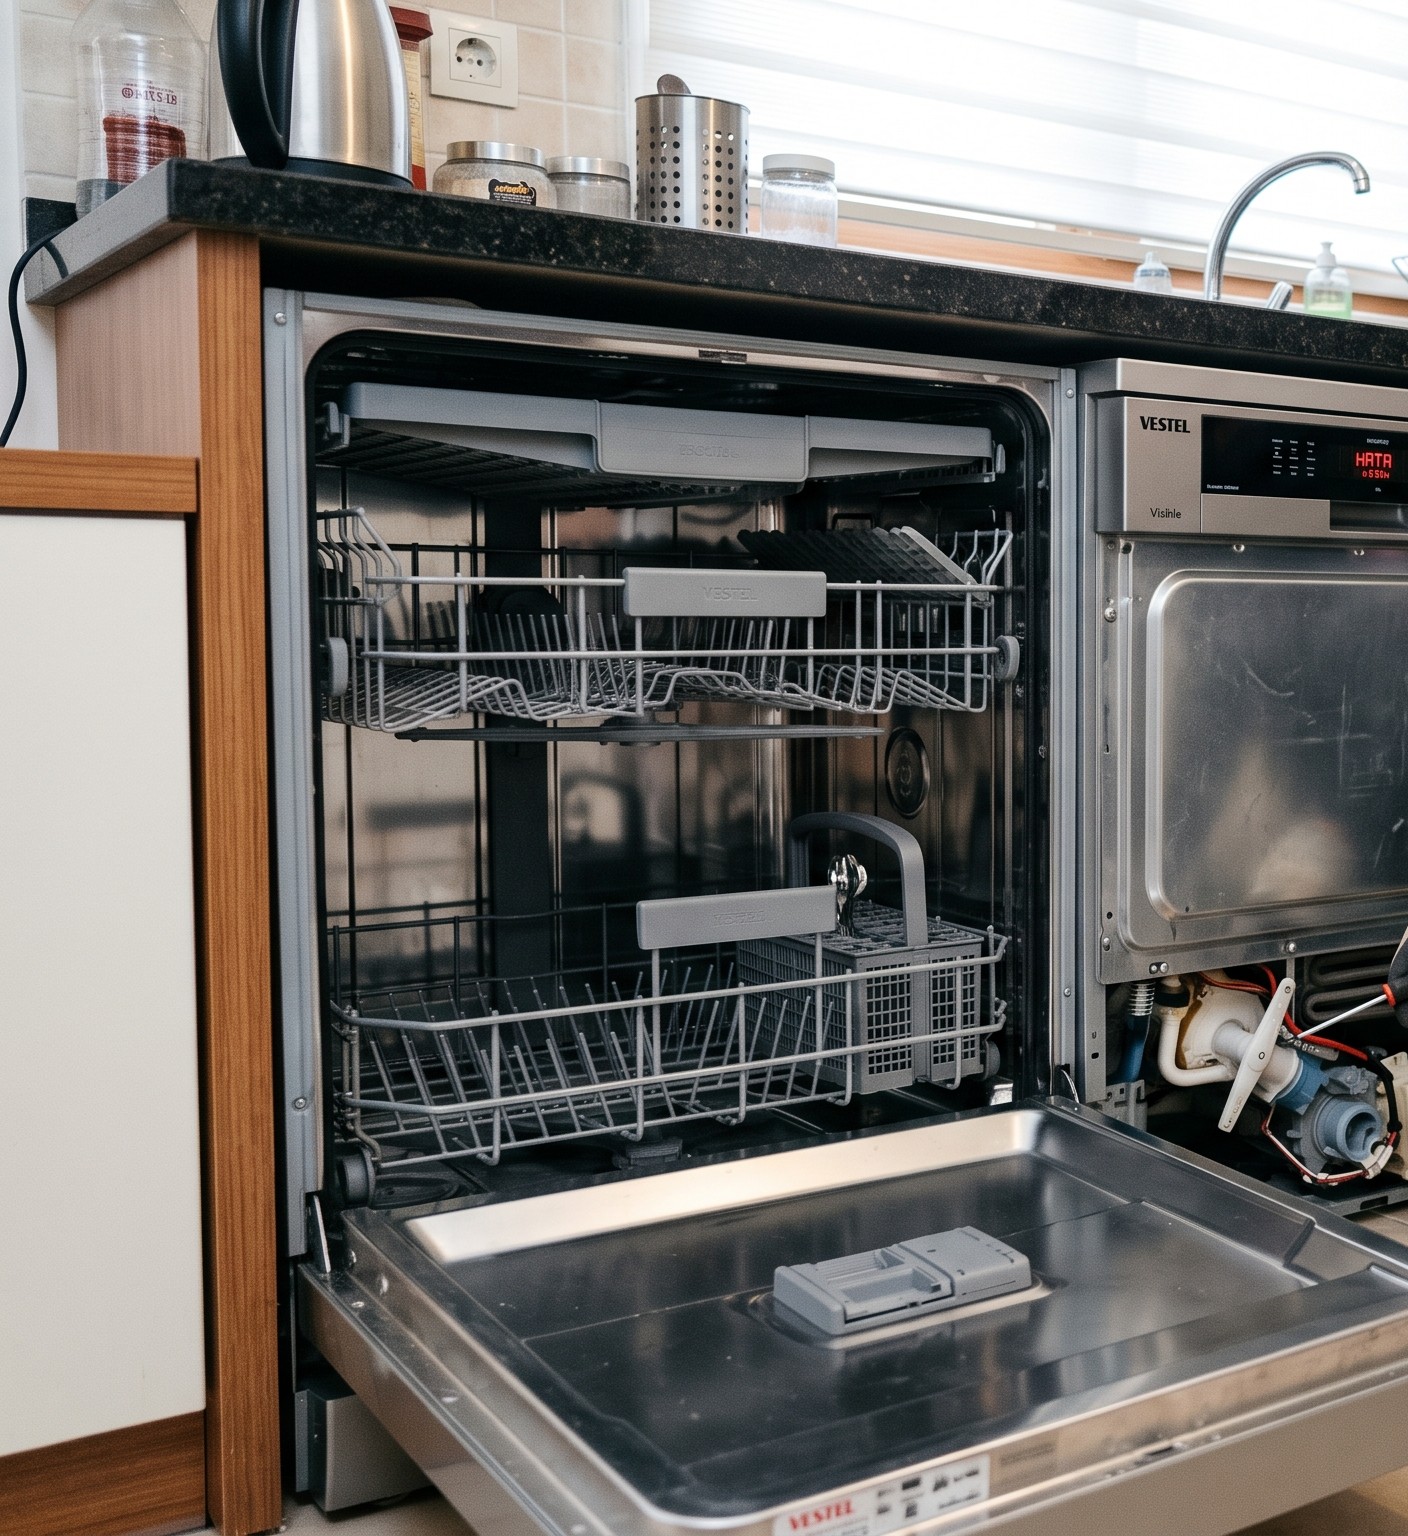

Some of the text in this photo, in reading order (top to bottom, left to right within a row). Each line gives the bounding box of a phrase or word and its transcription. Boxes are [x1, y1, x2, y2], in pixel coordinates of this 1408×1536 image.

[1140, 416, 1190, 433] VESTEL
[1355, 452, 1392, 469] HATA
[789, 1500, 853, 1531] VESTEL
